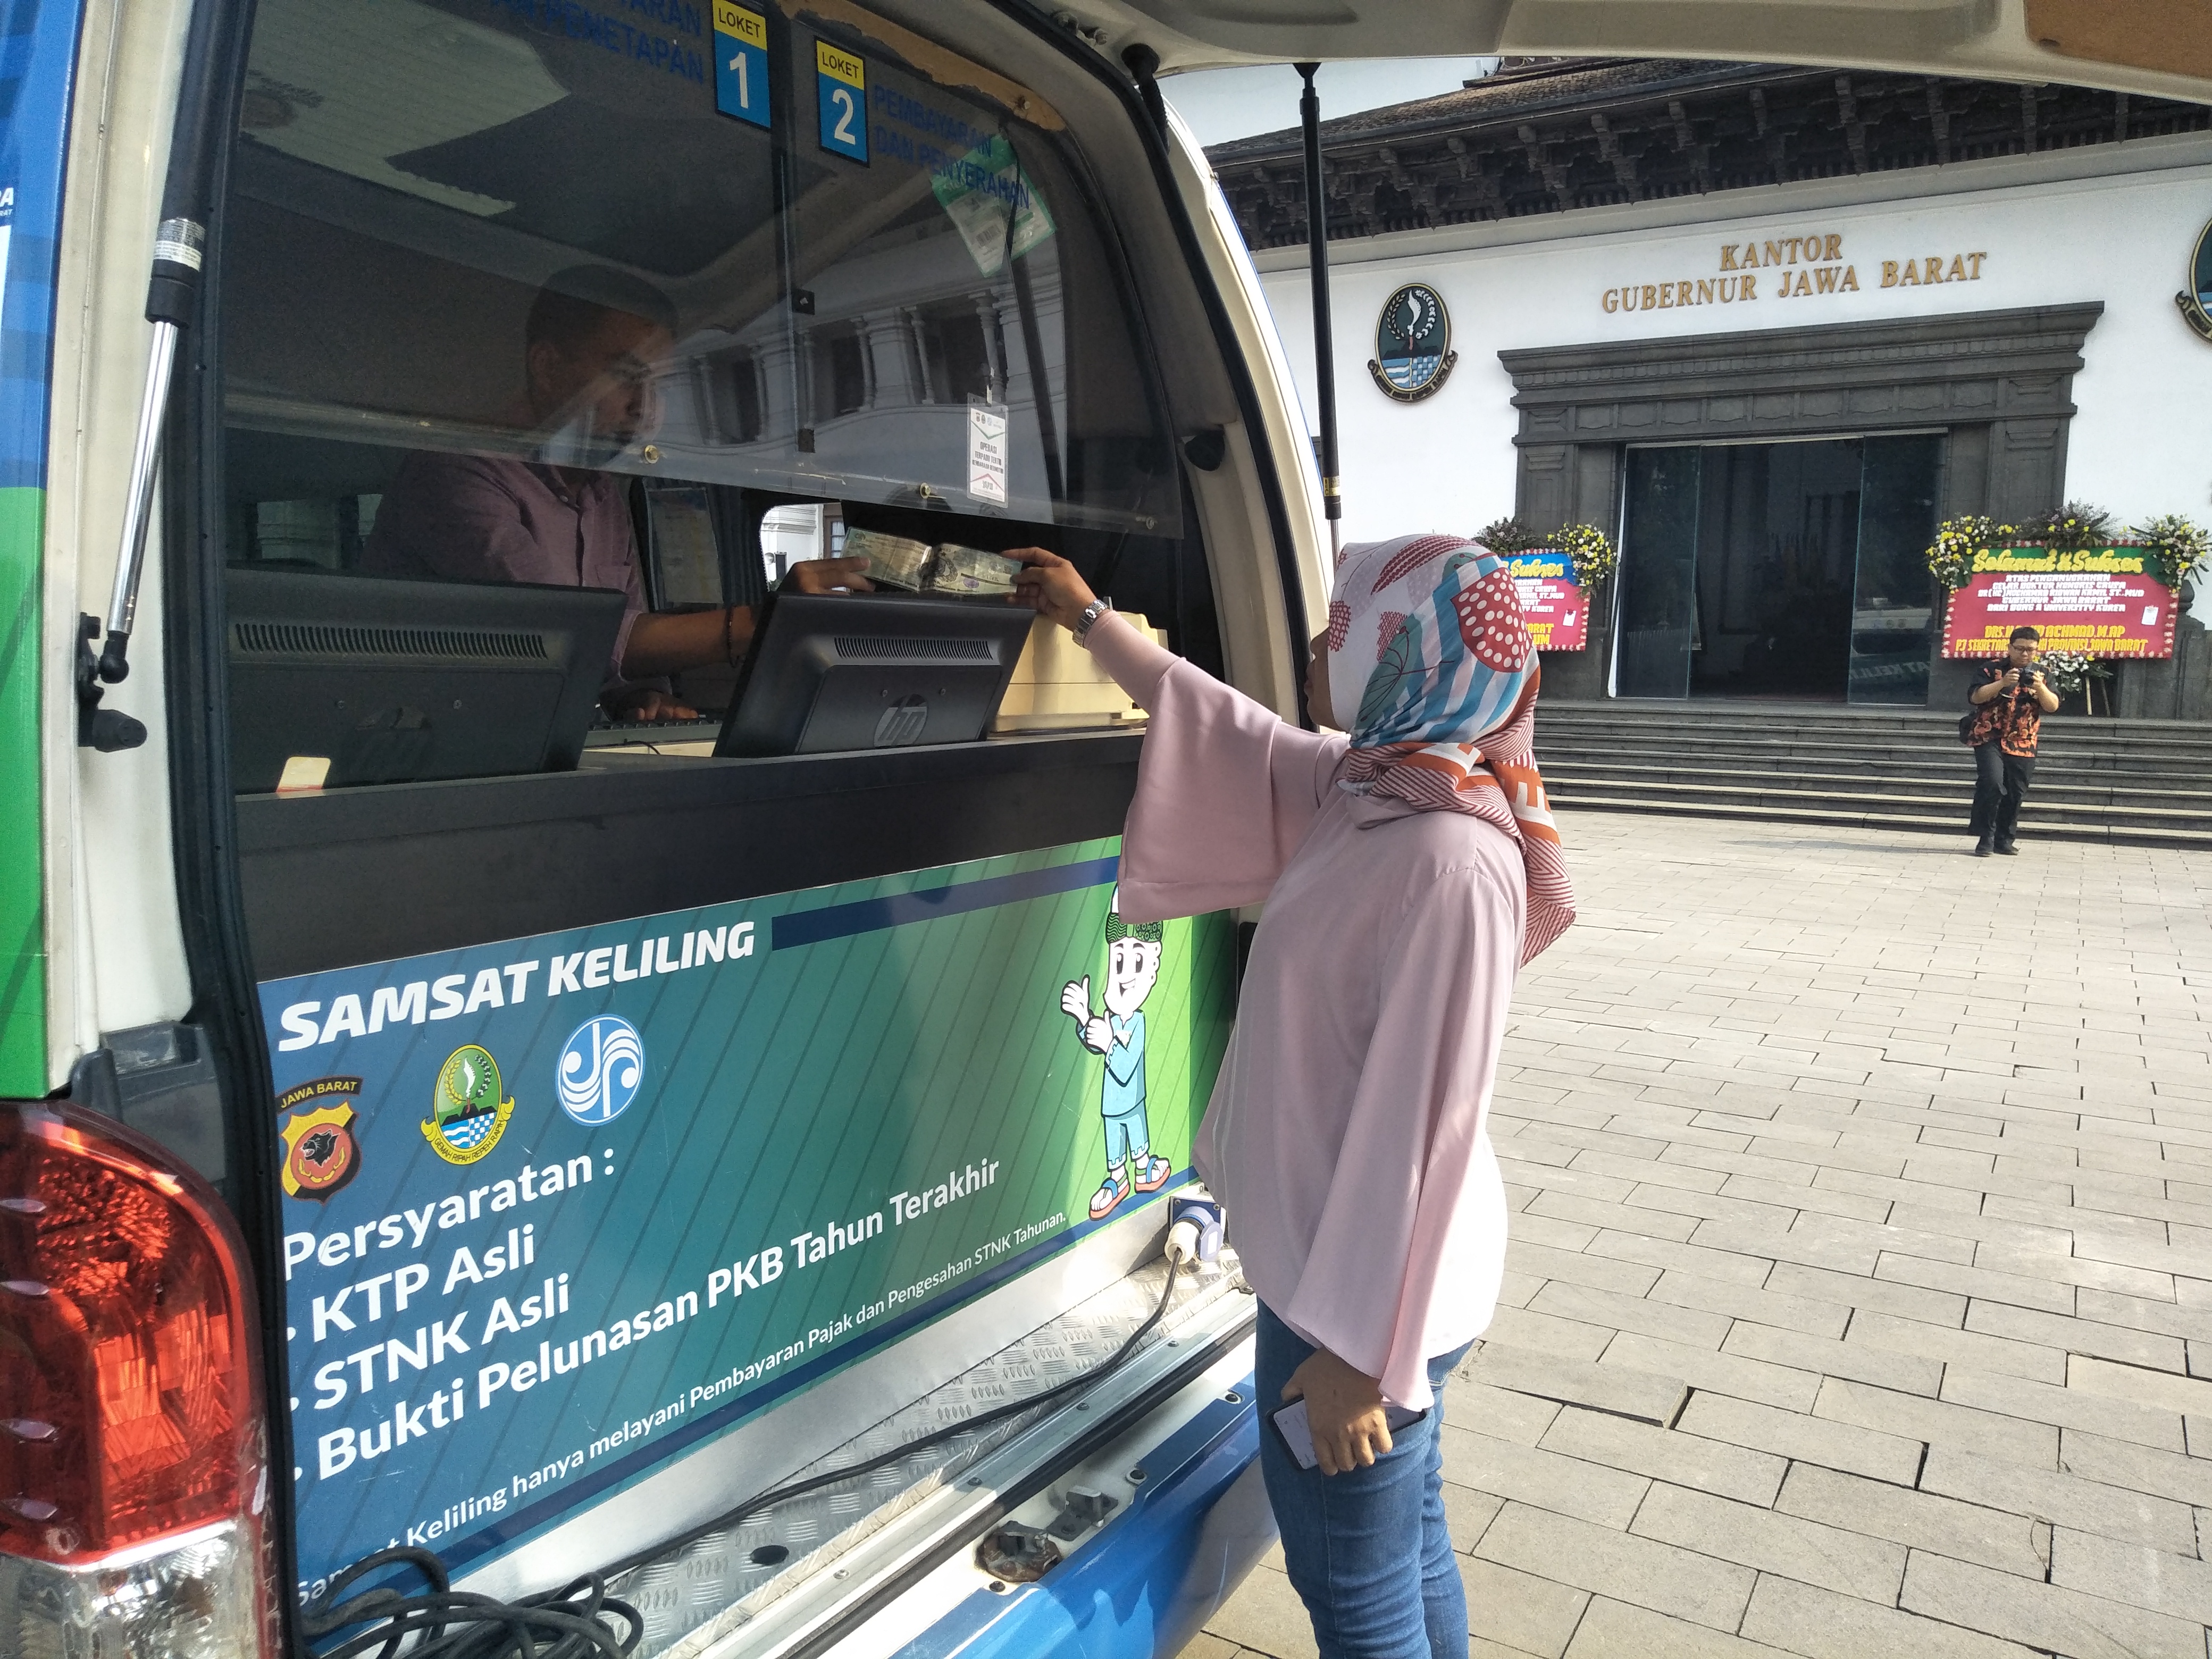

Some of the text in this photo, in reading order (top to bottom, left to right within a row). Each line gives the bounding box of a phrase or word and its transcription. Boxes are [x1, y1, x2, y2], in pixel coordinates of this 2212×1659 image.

[718, 7, 760, 38] LOKET
[729, 52, 749, 109] 1
[822, 52, 859, 79] LOKET
[832, 89, 856, 145] 2
[875, 125, 914, 164] DAN
[1719, 233, 1843, 272] KANTOR
[1601, 252, 1987, 313] GUBERNUR JAWA BARAT
[980, 442, 997, 455] OPERASI
[1510, 559, 1564, 578] Sukses
[2071, 550, 2144, 573] Sukses
[1527, 623, 1555, 633] ARAT
[279, 921, 755, 1052] SAMSAT KELILING
[281, 1081, 357, 1109] JAWA BARAT
[434, 1120, 505, 1162] GEMAH RIPAH REPEH RAPIH
[283, 1153, 593, 1280] Persyaratan
[312, 1223, 534, 1343] KTP Asli
[319, 1157, 1000, 1481] Bukti Pelunasan PKB Tahun Terakhir
[313, 1272, 569, 1410] STNK Asli
[407, 1487, 507, 1547] Keliling
[513, 1451, 584, 1498] hanya
[589, 1395, 685, 1460] melayani
[691, 1340, 804, 1409] Pembayaran
[808, 1310, 853, 1349] Pajak
[856, 1300, 885, 1325] dan
[888, 1256, 972, 1311] Pengesahan
[974, 1233, 1012, 1265] STNK
[1013, 1212, 1067, 1250] Tahunan.
